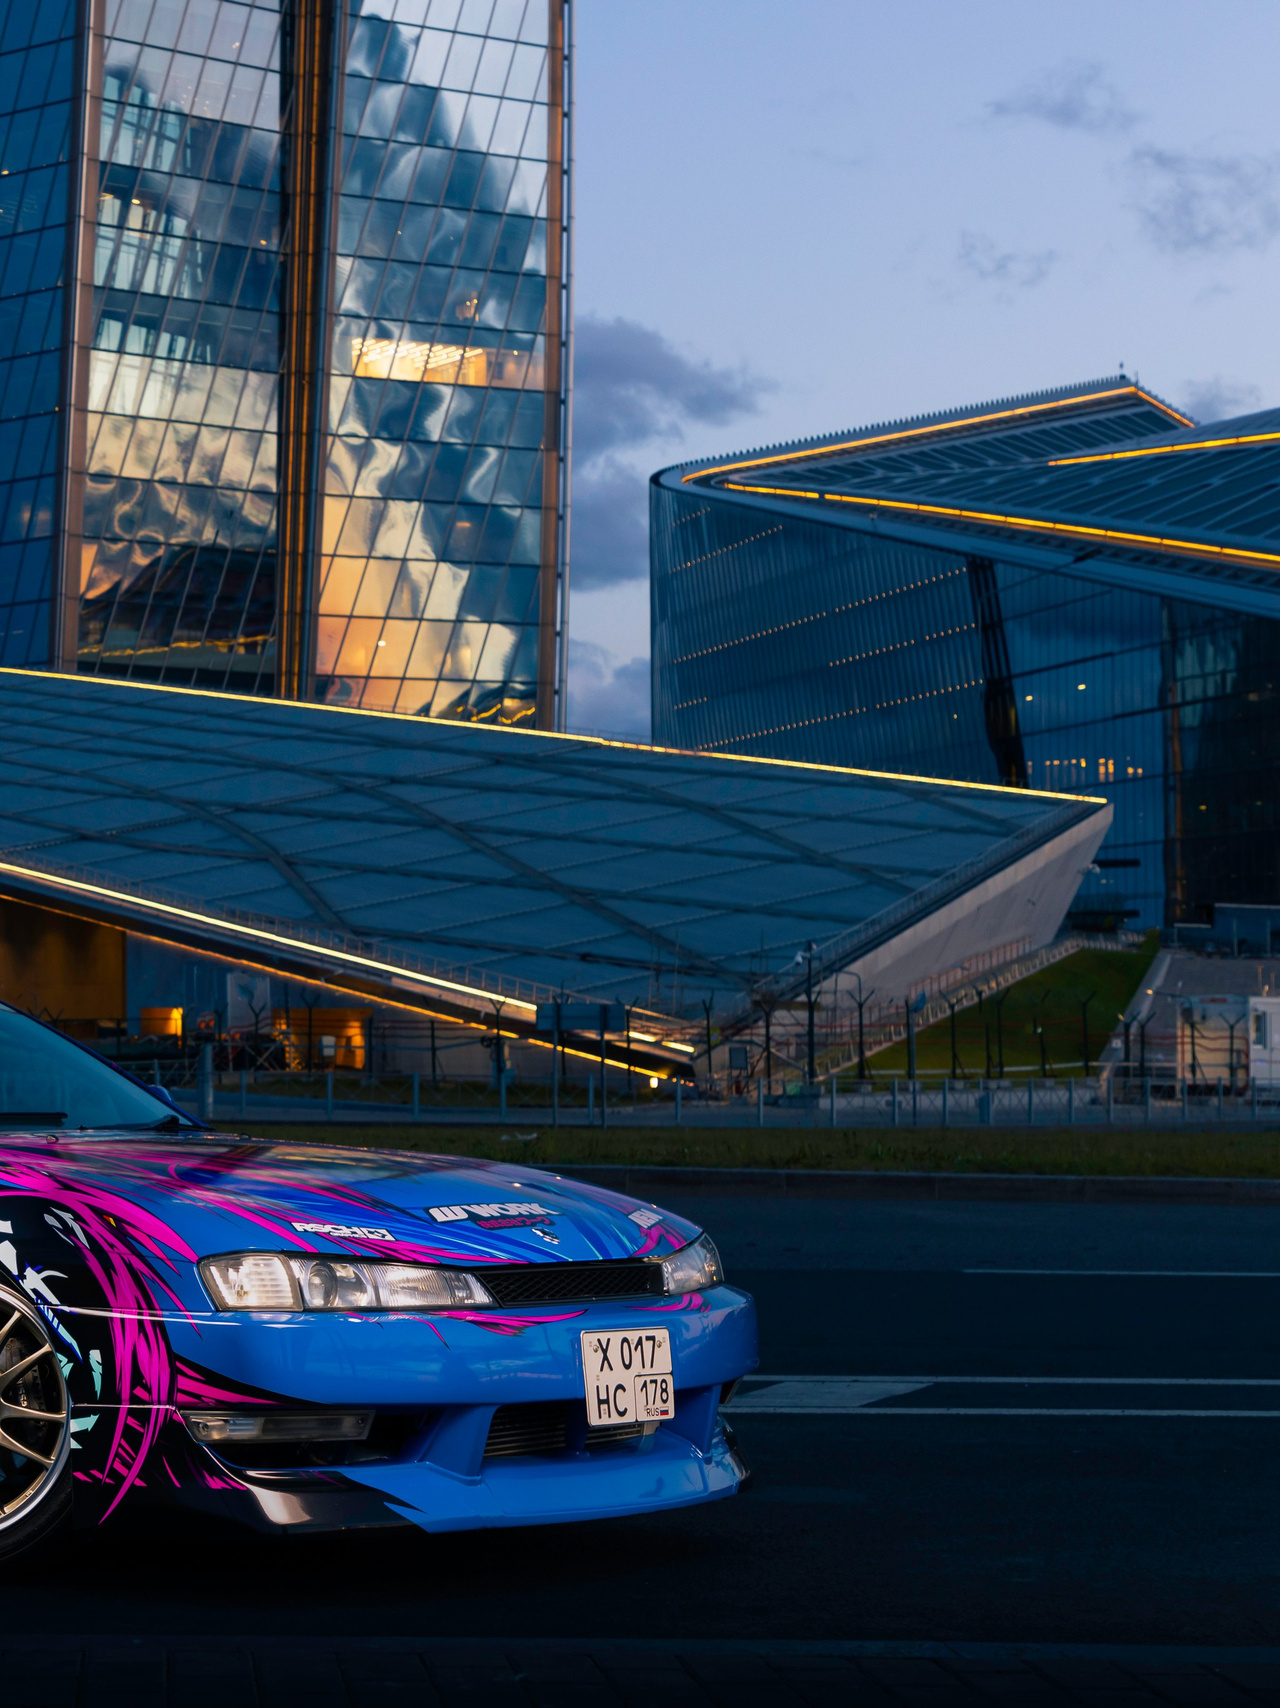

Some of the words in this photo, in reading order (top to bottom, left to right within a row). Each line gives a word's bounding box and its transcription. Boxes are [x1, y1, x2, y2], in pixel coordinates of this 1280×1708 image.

[461, 1202, 562, 1217] WORK
[290, 1222, 366, 1237] RSCH
[620, 1335, 656, 1370] 017
[640, 1378, 669, 1406] 178
[646, 1407, 660, 1417] RUS
